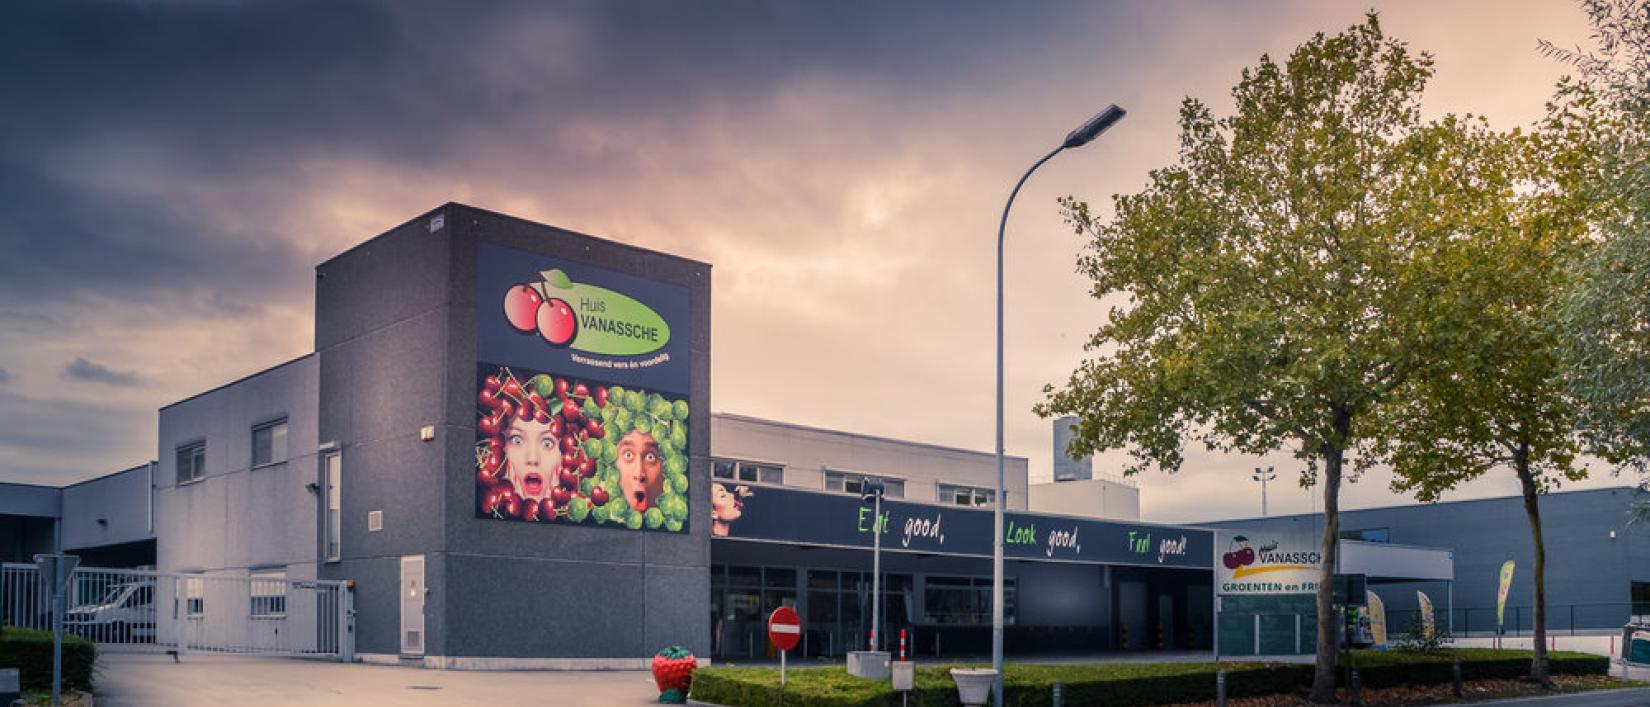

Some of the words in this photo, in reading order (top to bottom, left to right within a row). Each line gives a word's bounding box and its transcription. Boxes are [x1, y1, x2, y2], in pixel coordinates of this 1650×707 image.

[580, 296, 606, 312] Huis
[580, 314, 658, 342] VANASSCHE
[902, 513, 944, 547] good,
[1006, 521, 1037, 544] Look
[1046, 526, 1080, 557] good,
[1128, 531, 1151, 553] Feel
[1158, 535, 1187, 562] good!
[1222, 582, 1282, 592] GROENTEN
[1285, 584, 1299, 592] en
